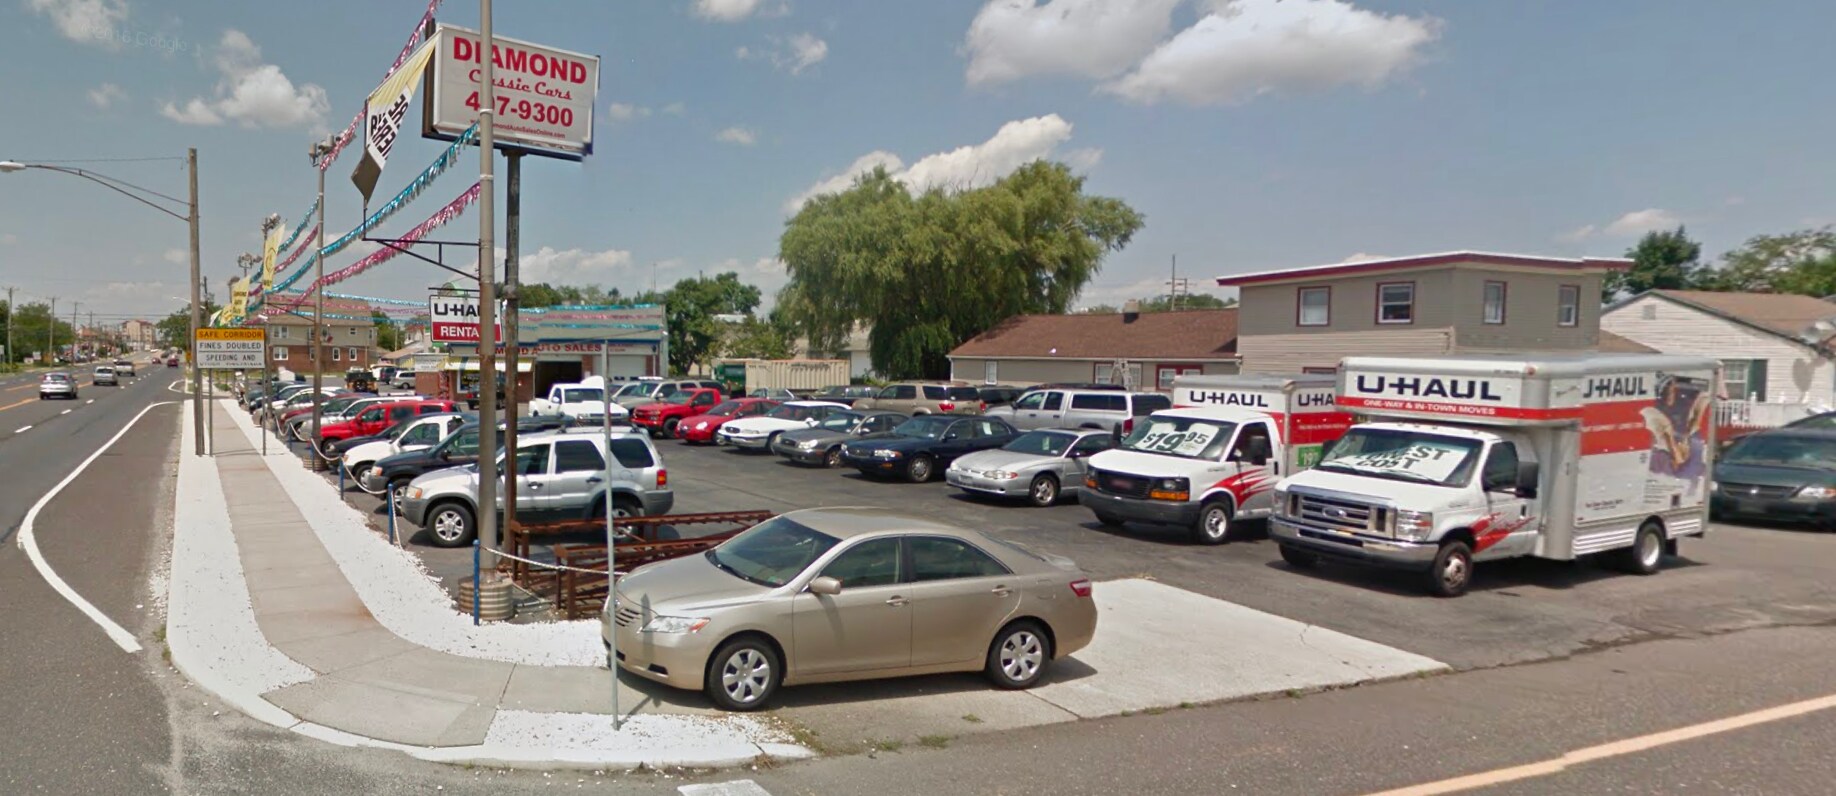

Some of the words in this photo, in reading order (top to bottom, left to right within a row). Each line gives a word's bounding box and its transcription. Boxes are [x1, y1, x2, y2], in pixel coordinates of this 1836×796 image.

[468, 69, 531, 93] Cssic
[534, 81, 572, 101] Cars
[465, 91, 573, 127] 47-9300
[564, 342, 602, 353] SALES
[1189, 390, 1269, 408] U-HAUL
[1357, 375, 1502, 401] U-HAUL
[1363, 399, 1403, 408] ONE-WAY
[1415, 403, 1457, 412] IN-TOWN
[1459, 406, 1496, 415] MOVES
